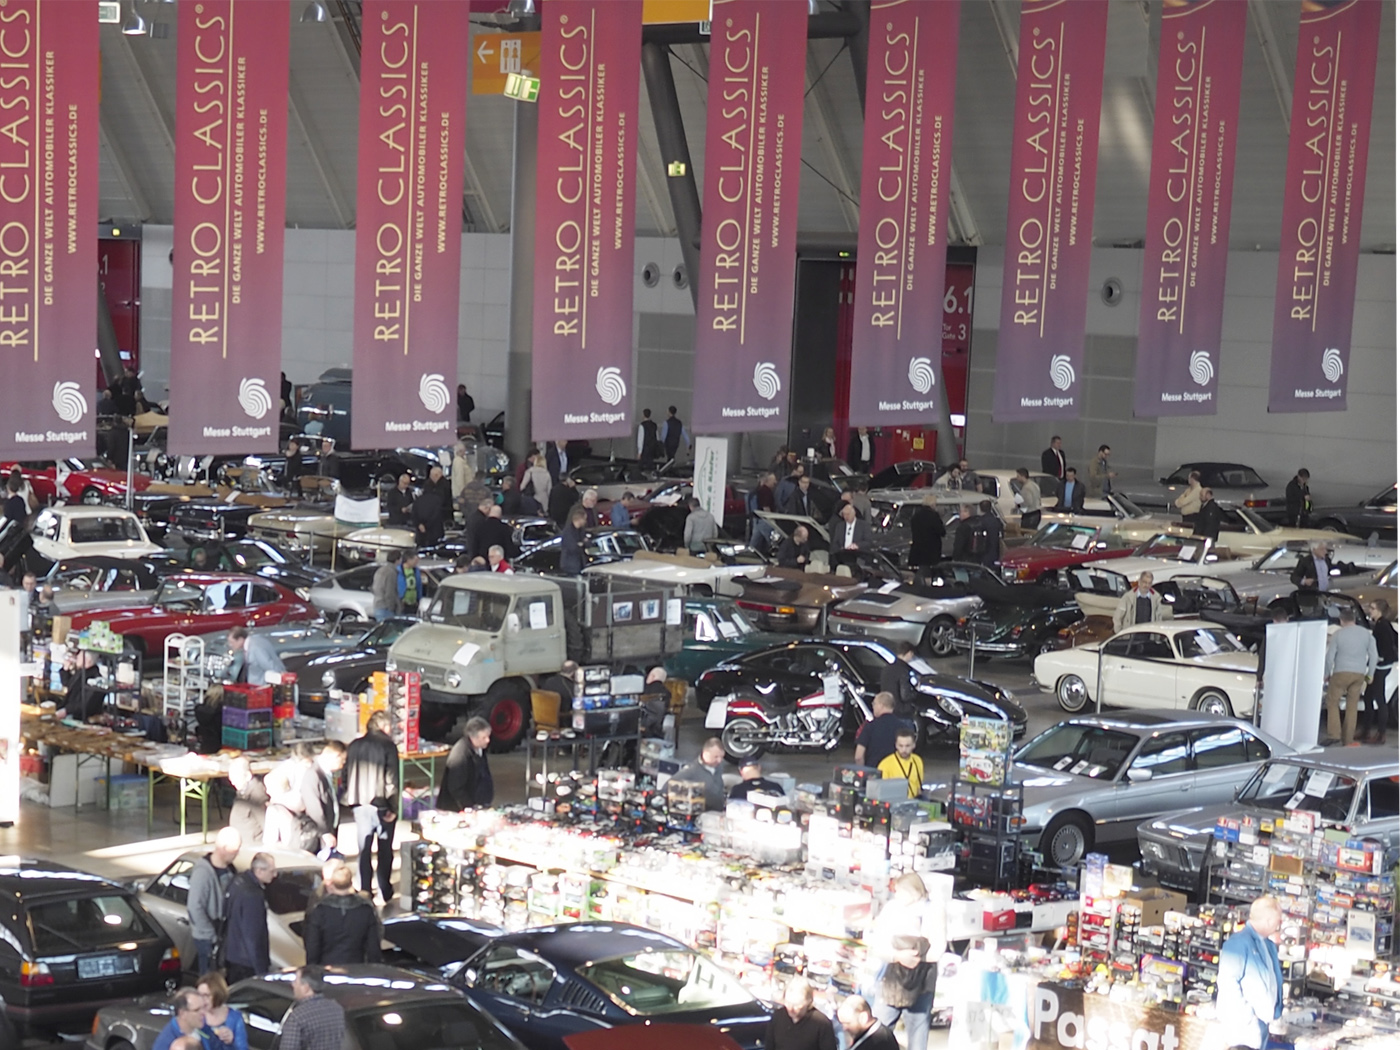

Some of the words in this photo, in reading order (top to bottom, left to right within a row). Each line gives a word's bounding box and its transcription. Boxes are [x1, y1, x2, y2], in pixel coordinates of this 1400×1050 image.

[45, 51, 55, 114] KLASSIKER
[236, 57, 246, 118] KLASSIKER
[419, 62, 429, 122] KLASSIKER
[595, 64, 606, 122] KLASSIKER
[758, 67, 769, 123] KLASSIKER
[915, 70, 925, 124] KLASSIKER
[1061, 74, 1071, 127] KLASSIKER
[1202, 77, 1212, 129] KLASSIKER
[1336, 80, 1347, 131] KLASSIKER
[44, 119, 55, 205] AUTOMOBILER
[67, 104, 78, 254] WWW.RETROCLASSICS.DE
[233, 122, 245, 206] AUTOMOBILER
[256, 109, 268, 254] WWW.RETROCLASSICS.DE
[416, 126, 427, 207] AUTOMOBILER
[593, 125, 604, 205] AUTOMOBILER
[614, 112, 626, 249] WWW.RETROCLASSICS.DE
[755, 127, 766, 204] AUTOMOBILER
[771, 114, 785, 247] WWW.RETROCLASSICS.DE
[911, 128, 921, 203] AUTOMOBILER
[927, 116, 943, 245] WWW.RETROCLASSICS.DE
[1056, 131, 1067, 204] AUTOMOBILER
[1197, 133, 1207, 203] AUTOMOBILER
[1330, 135, 1343, 204] AUTOMOBILER
[437, 112, 450, 253] WWW.RETROCLASSICS.DE
[1069, 119, 1084, 245] WWW.RETROCLASSICS.DE
[1210, 121, 1225, 244] WWW.RETROCLASSICS.DE
[1341, 124, 1358, 244] WWW.RETROCLASSICS.DE
[44, 208, 54, 239] WELT
[233, 210, 243, 239] WELT
[415, 210, 424, 239] WELT
[592, 208, 601, 236] WELT
[753, 207, 762, 235] WELT
[909, 207, 917, 233] WELT
[1053, 207, 1061, 233] WELT
[1194, 207, 1202, 232] WELT
[1327, 208, 1336, 232] WELT
[43, 243, 54, 282] GANZE
[232, 243, 243, 281] GANZE
[414, 243, 423, 280] GANZE
[590, 240, 600, 276] GANZE
[751, 238, 761, 273] GANZE
[907, 237, 916, 270] GANZE
[1051, 237, 1060, 270] GANZE
[1157, 218, 1183, 322] RETRO
[1191, 236, 1200, 268] GANZE
[1290, 218, 1318, 320] RETRO
[1324, 236, 1334, 267] GANZE
[0, 221, 30, 347] RETRO
[189, 222, 222, 344] RETRO
[373, 223, 403, 341] RETRO
[554, 220, 582, 336] RETRO
[590, 279, 599, 297] DIE
[712, 219, 742, 331] RETRO
[750, 277, 759, 293] DIE
[871, 218, 900, 327] RETRO
[906, 275, 914, 290] DIE
[1014, 218, 1044, 325] RETRO
[1049, 274, 1057, 289] DIE
[1323, 271, 1331, 286] DIE
[43, 286, 53, 305] DIE
[231, 285, 242, 304] DIE
[414, 284, 422, 301] DIE
[943, 285, 973, 314] 6.1
[958, 323, 966, 340] 3
[722, 408, 745, 417] Messe
[747, 407, 780, 418] Stuttgart
[879, 401, 901, 410] Messe
[903, 400, 934, 411] Stuttgart
[1021, 398, 1042, 406] Messe
[1044, 397, 1073, 408] Stuttgart
[1162, 393, 1182, 401] Messe
[1183, 392, 1211, 402] Stuttgart
[1295, 389, 1314, 398] Messe
[1315, 388, 1341, 399] Stuttgart
[15, 432, 44, 443] Messe
[46, 431, 87, 443] Stuttgart
[203, 427, 230, 437] Messe
[232, 426, 271, 439] Stuttgart
[385, 422, 411, 432] Messe
[413, 420, 450, 432] Stuttgart
[564, 414, 589, 424] Messe
[590, 412, 625, 424] Stuttgart
